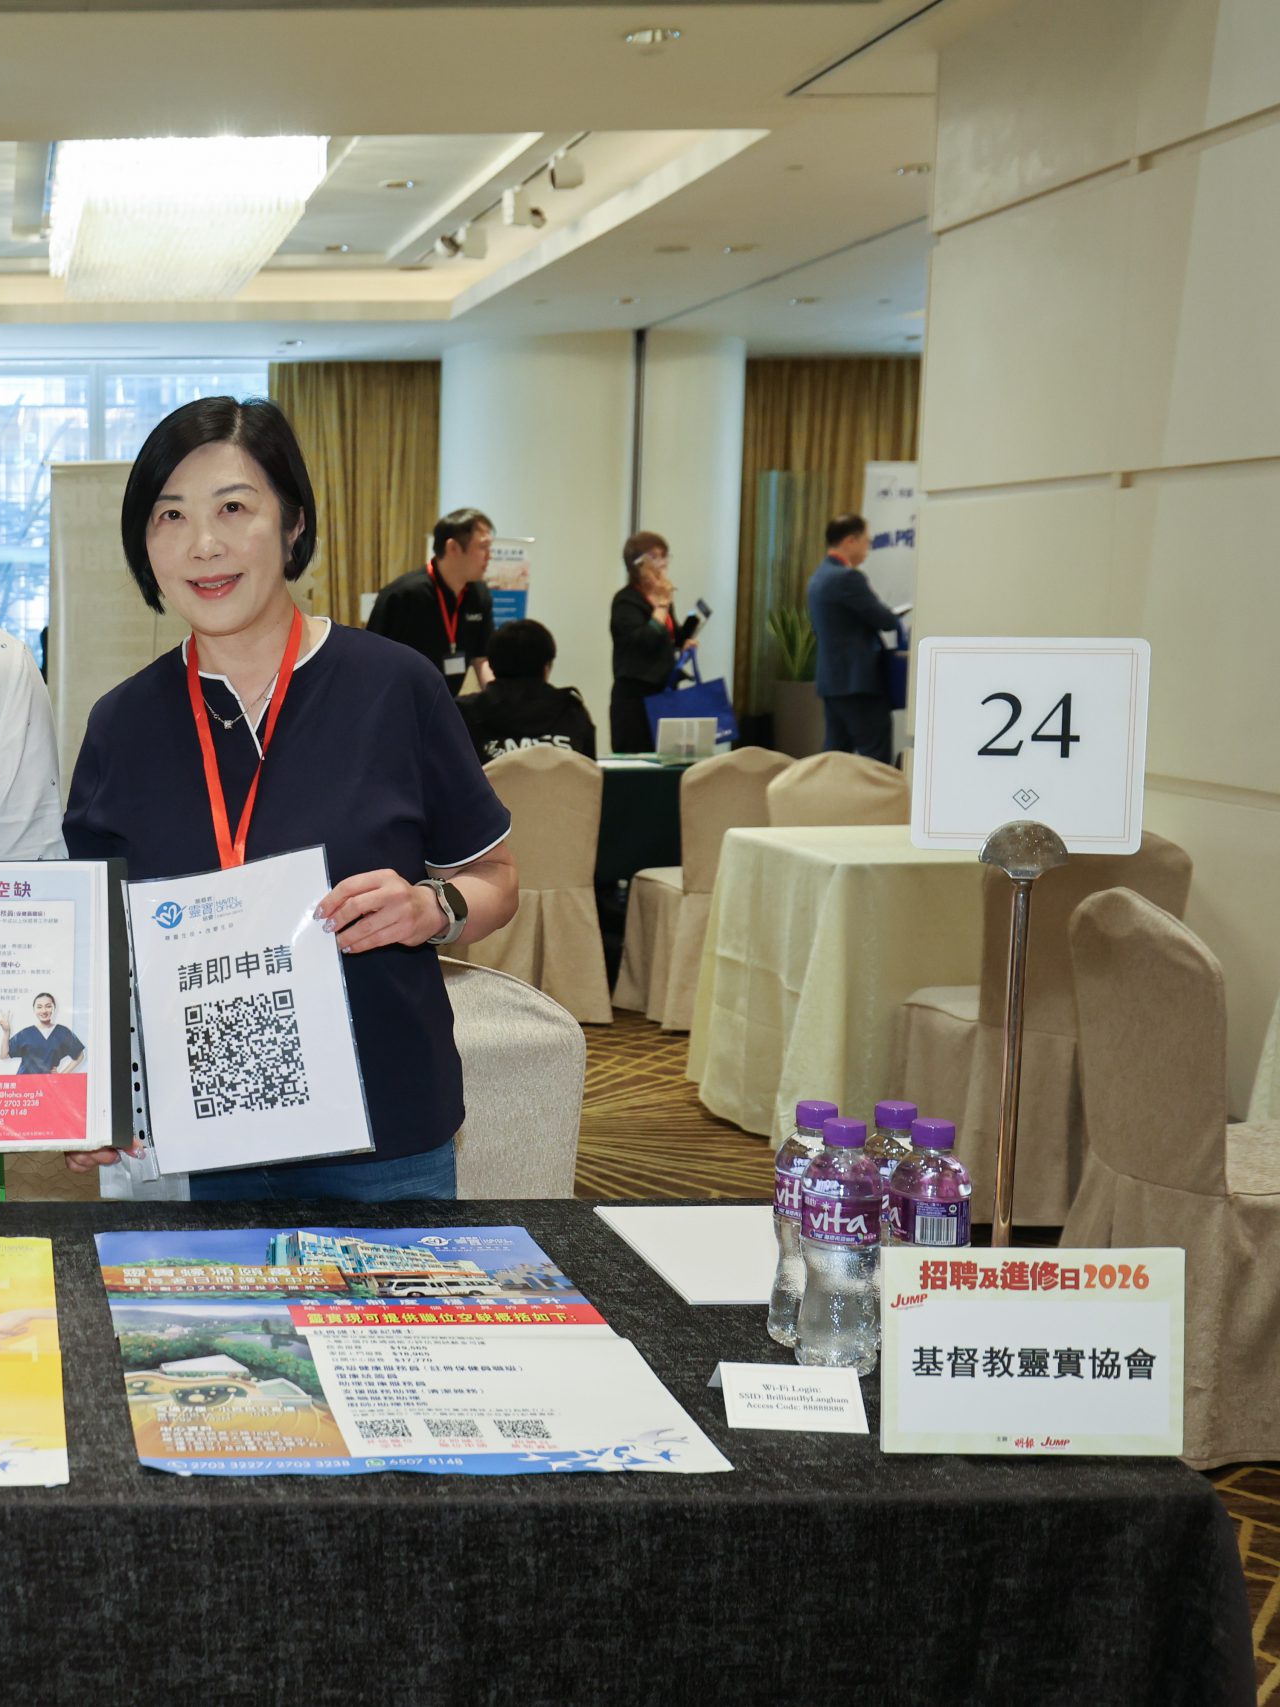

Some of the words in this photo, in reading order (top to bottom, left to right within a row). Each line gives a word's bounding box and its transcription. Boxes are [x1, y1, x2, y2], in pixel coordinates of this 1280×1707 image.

[978, 691, 1081, 760] 24
[177, 943, 293, 993] 請即申請
[776, 1178, 802, 1209] vit
[809, 1201, 869, 1235] vita
[919, 1260, 1150, 1291] 招聘及進修日2026
[890, 1292, 928, 1308] JUMP
[912, 1346, 1157, 1380] 基督教靈實協會
[738, 1392, 764, 1400] SSID:
[762, 1383, 789, 1392] Wi-Fi
[746, 1401, 774, 1409] Access
